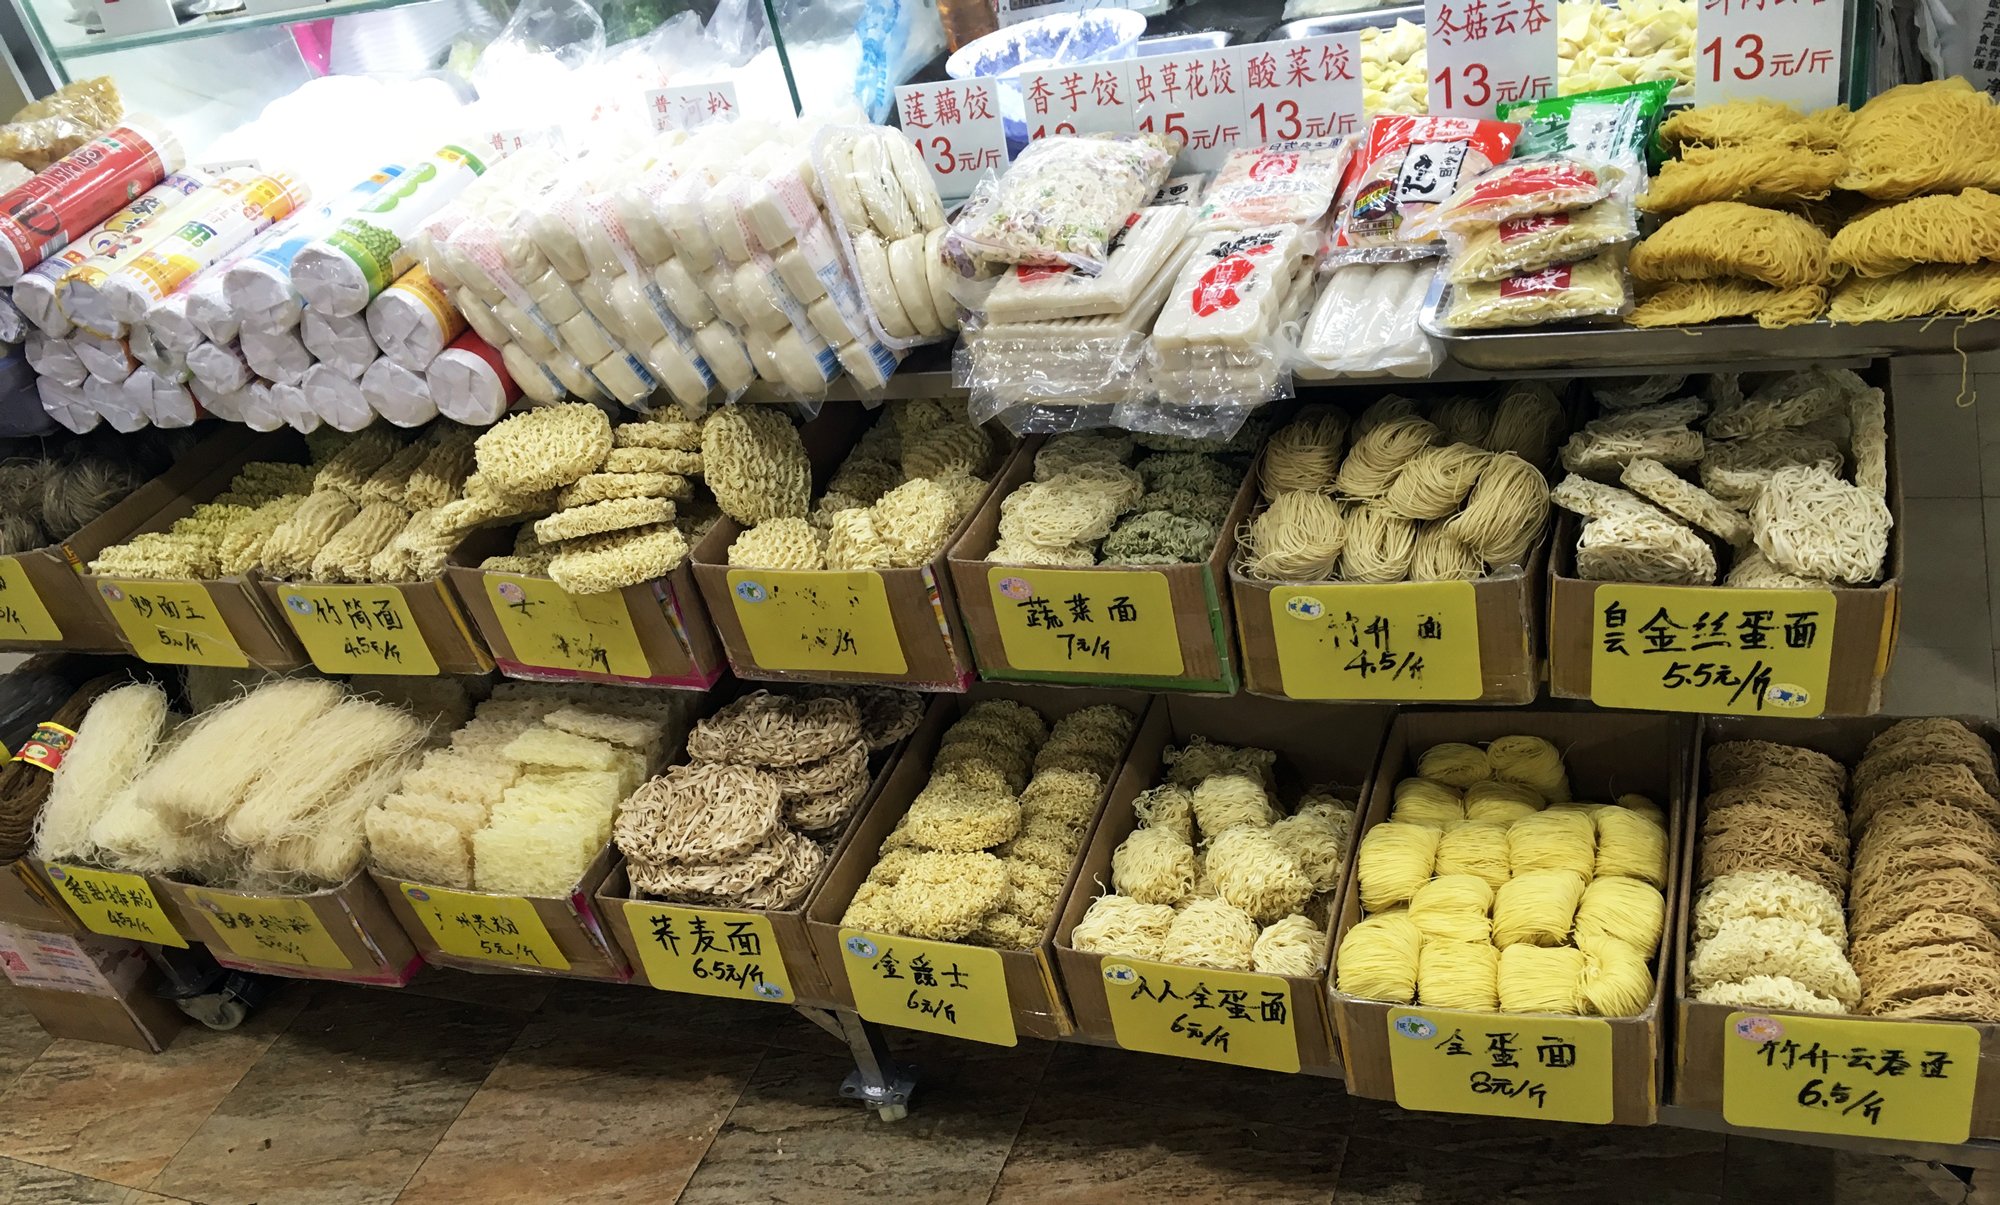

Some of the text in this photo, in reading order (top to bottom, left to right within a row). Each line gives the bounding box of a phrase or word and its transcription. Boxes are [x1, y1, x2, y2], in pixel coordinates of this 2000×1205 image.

[1433, 0, 1552, 46] 冬菇云吞
[1247, 43, 1355, 90] 酸菜饺
[1703, 34, 1834, 82] 13元/斤
[1028, 70, 1125, 115] 香芋饺
[1136, 58, 1236, 103] 虫草花饺
[1435, 63, 1553, 109] 13元/斤
[904, 85, 995, 129] 莲藕饺
[1250, 100, 1358, 143] 13元/斤
[129, 594, 206, 620] 炒面王
[1017, 593, 1137, 629] 蔬菜面
[1057, 634, 1111, 661] 7元/斤
[1638, 607, 1819, 654] 金丝蛋面
[1662, 660, 1773, 711] 5.5元/斤
[649, 914, 761, 957] 荞麦面
[692, 958, 765, 989] 6.5元/斤
[1470, 1071, 1548, 1108] 8元/斤
